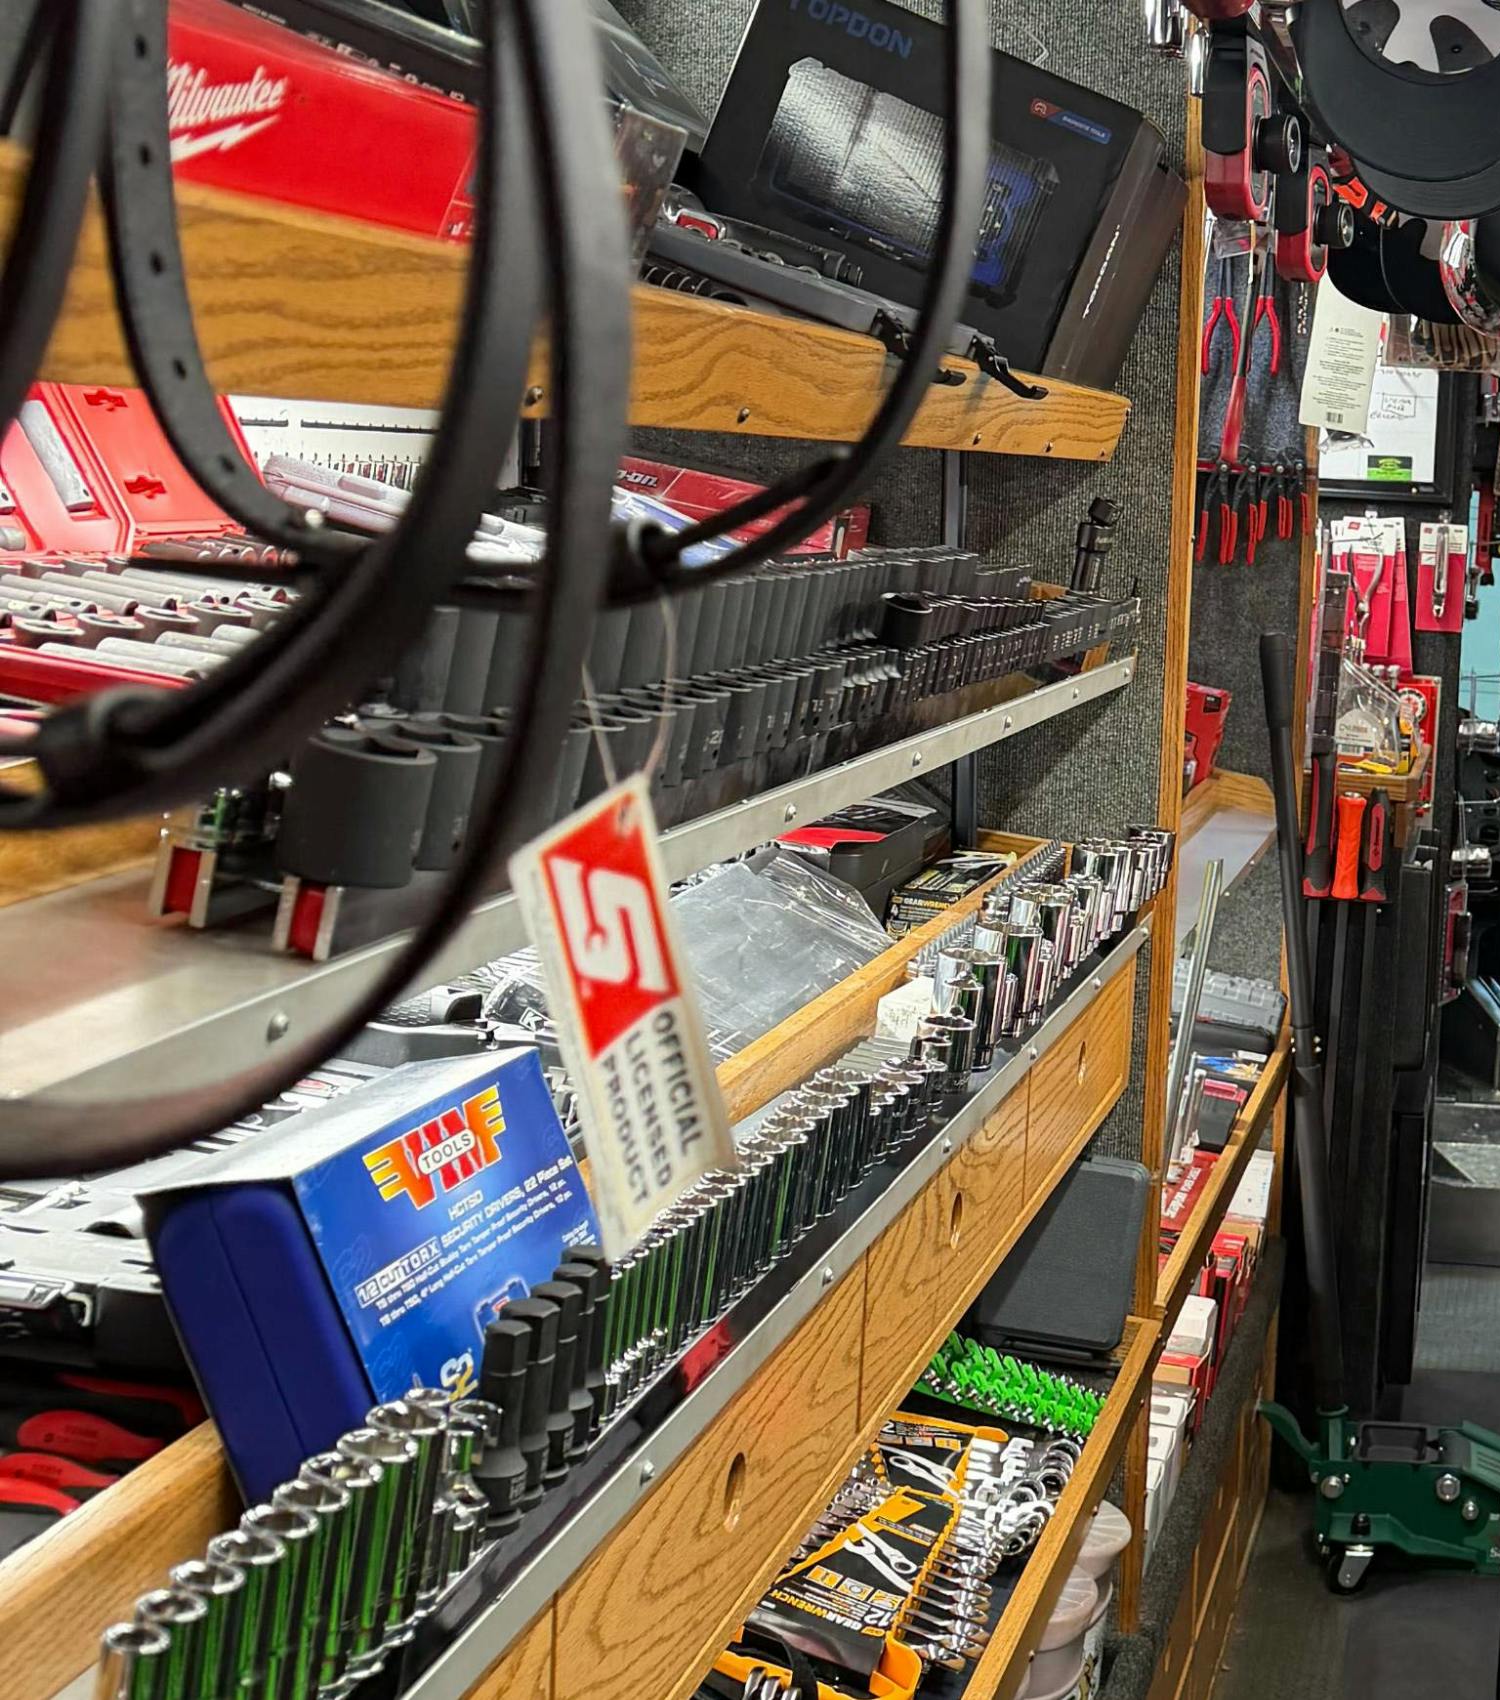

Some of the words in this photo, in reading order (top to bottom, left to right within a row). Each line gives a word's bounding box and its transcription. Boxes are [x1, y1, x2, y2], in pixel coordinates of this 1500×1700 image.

[652, 1009, 704, 1158] OFFICIAL
[601, 1057, 651, 1206] PRODUCT
[624, 1030, 673, 1191] LICENSED
[421, 1132, 473, 1171] TOOLS
[440, 1212, 484, 1248] SECURITY
[484, 1186, 526, 1219] DRIVERS,
[523, 1176, 538, 1193] 22
[536, 1164, 560, 1184] Piece
[557, 1155, 573, 1171] Set
[505, 1203, 529, 1223] Security
[511, 1215, 535, 1235] Security
[771, 1588, 862, 1631] GEARWRENCH
[864, 1606, 893, 1628] 12
